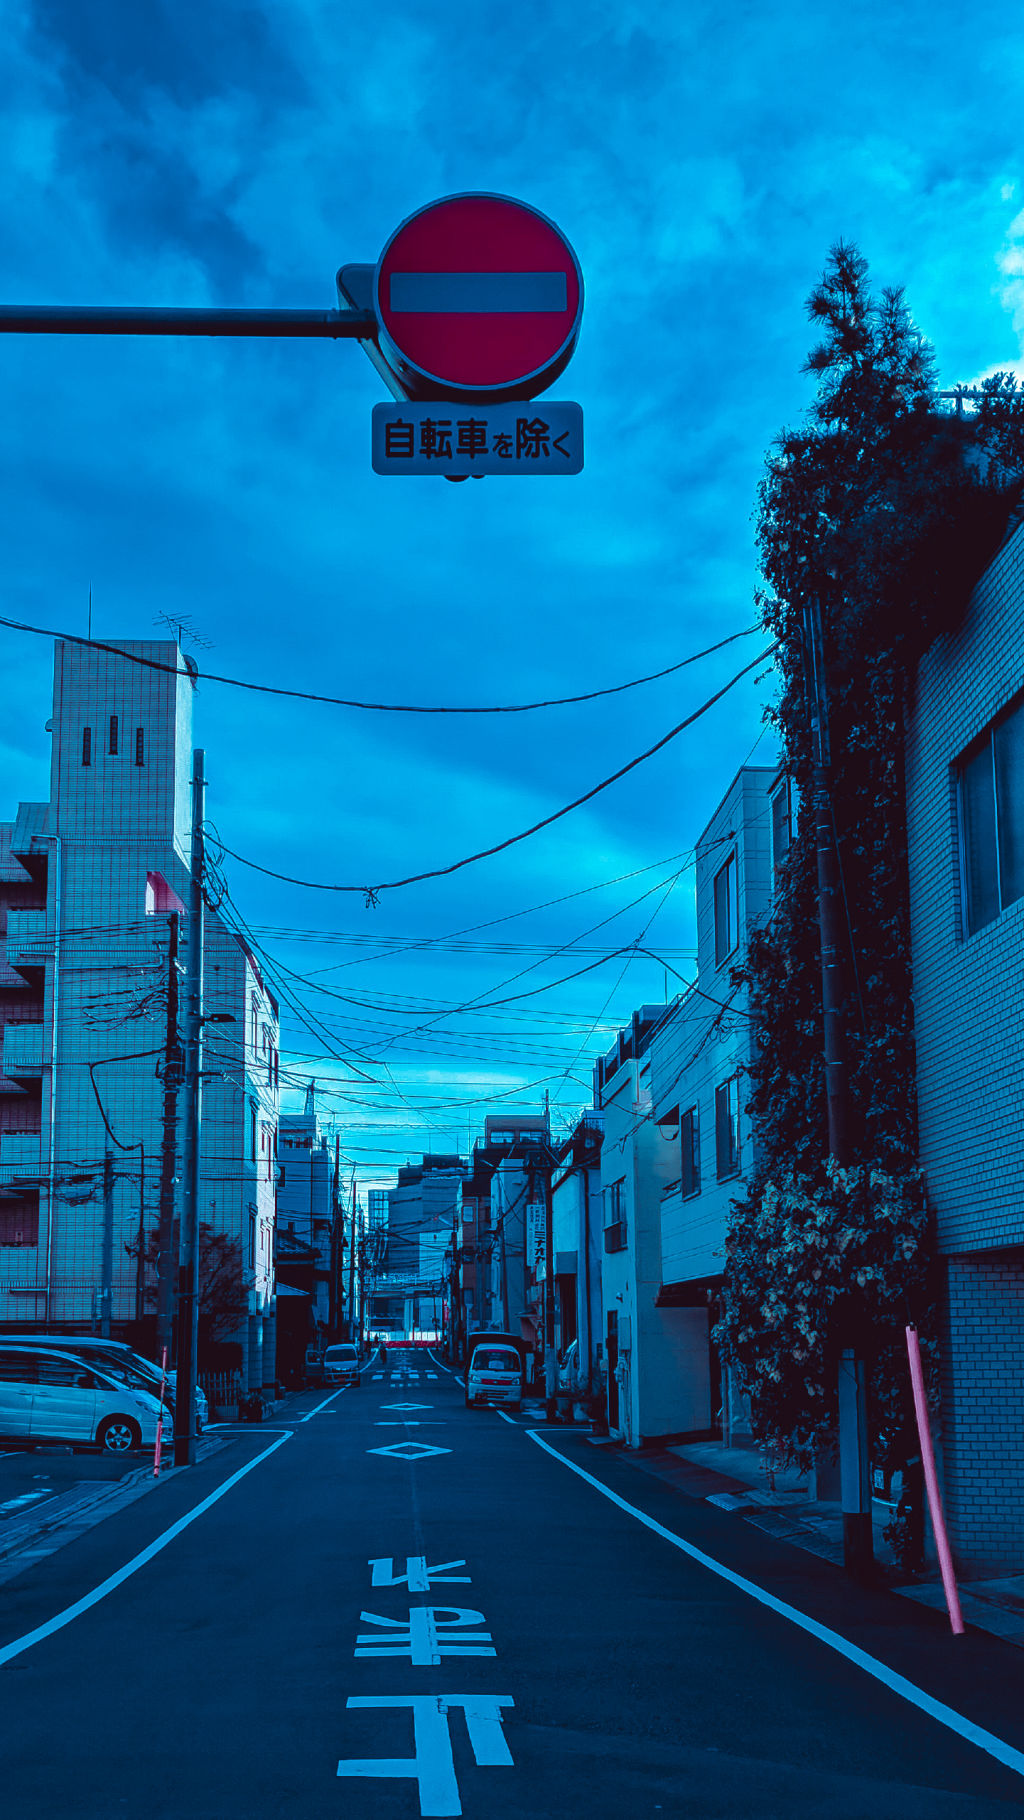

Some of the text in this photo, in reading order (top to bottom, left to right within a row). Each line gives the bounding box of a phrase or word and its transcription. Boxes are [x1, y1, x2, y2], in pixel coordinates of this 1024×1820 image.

[385, 417, 571, 459] 自転車を除く
[336, 1555, 516, 1817] 止まれ
